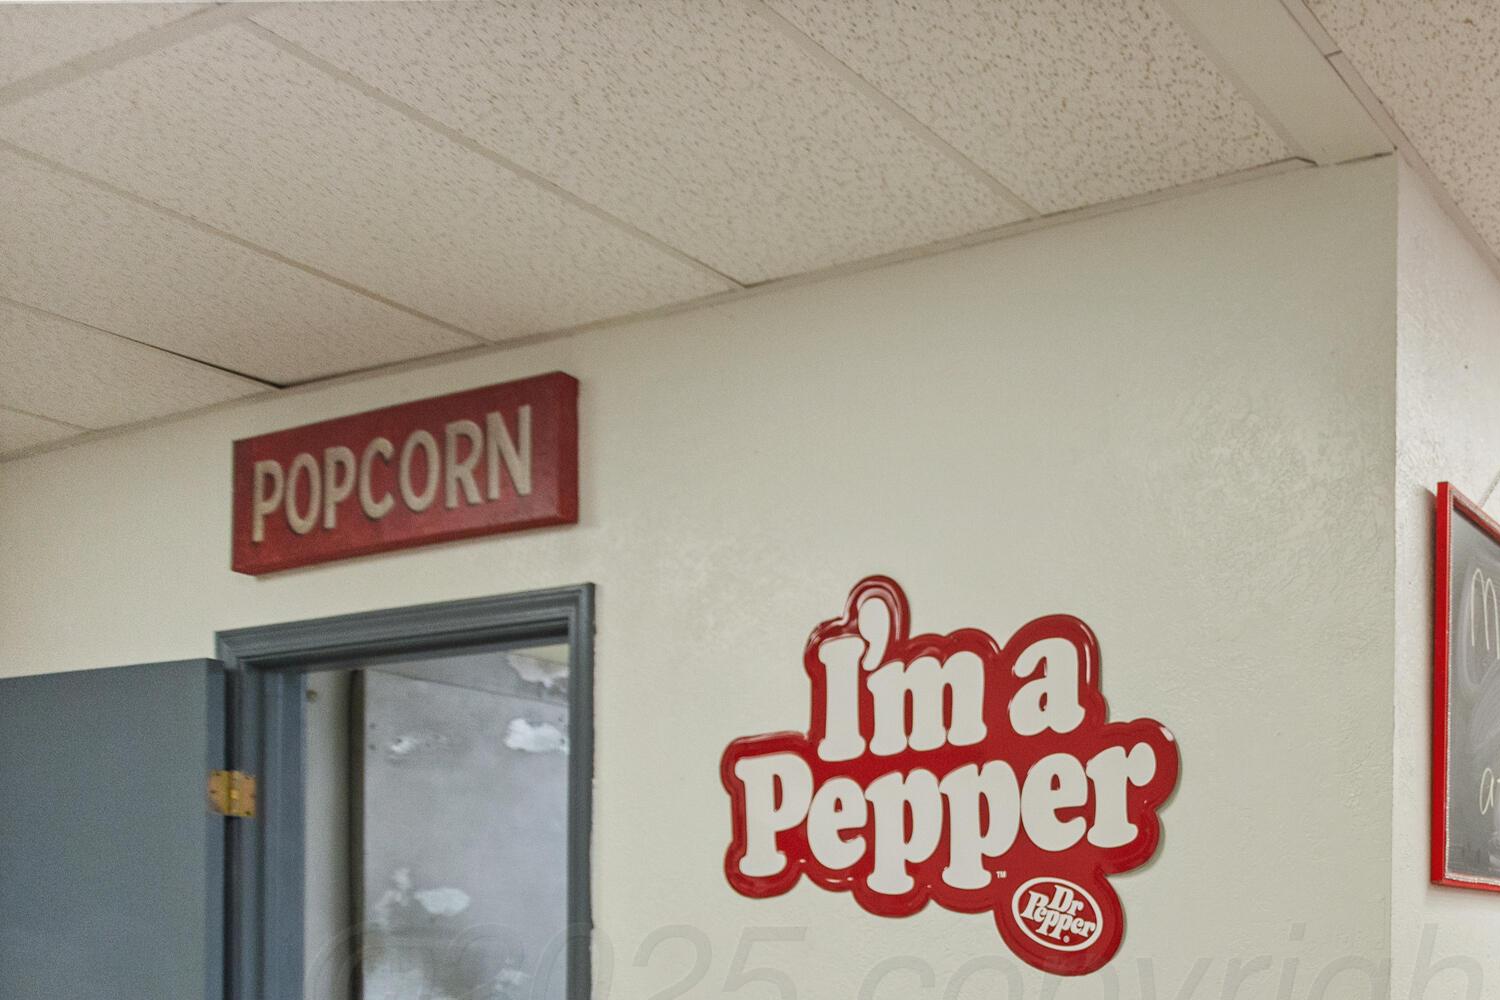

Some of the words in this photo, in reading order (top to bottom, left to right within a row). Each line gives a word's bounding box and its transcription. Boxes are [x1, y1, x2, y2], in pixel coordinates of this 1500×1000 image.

[251, 404, 532, 544] POPCORN
[818, 597, 988, 762] I'm
[1008, 637, 1086, 736] a
[735, 742, 1157, 895] Pepper
[1020, 890, 1096, 940] Pepper
[1047, 884, 1084, 916] Dr
